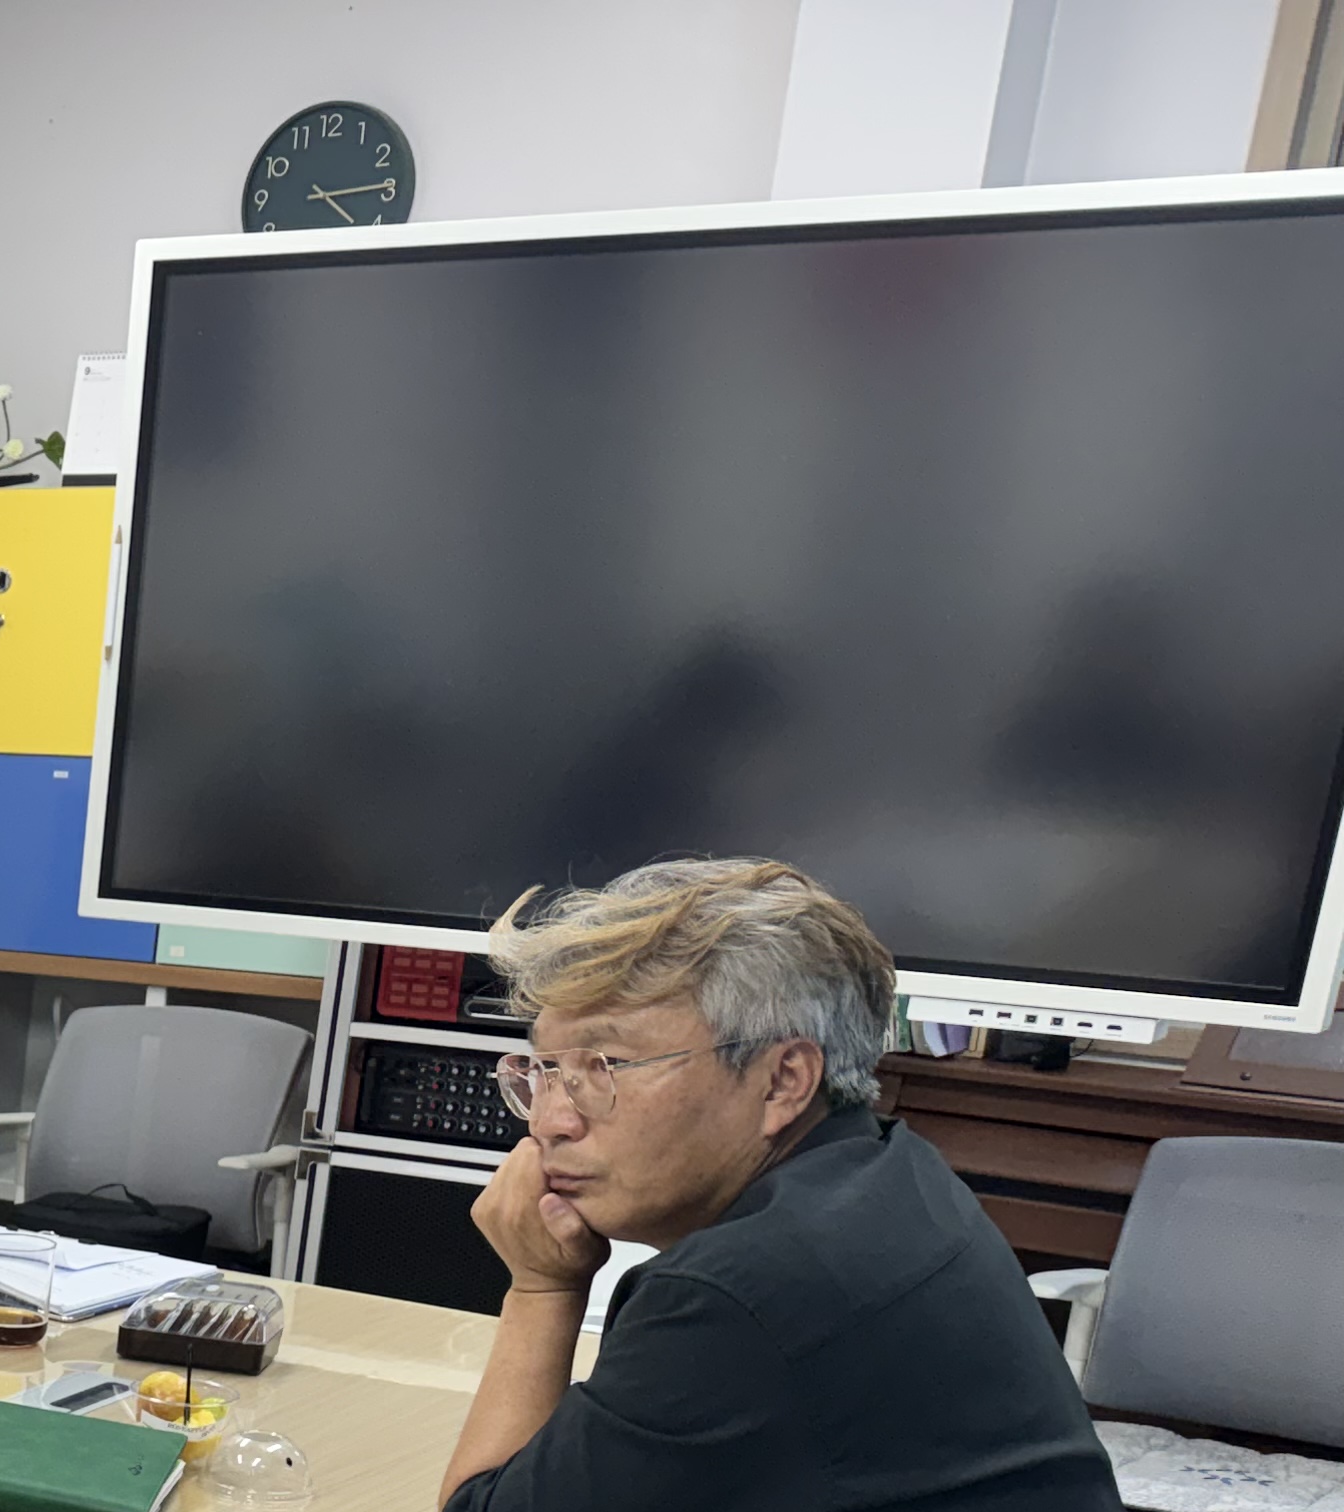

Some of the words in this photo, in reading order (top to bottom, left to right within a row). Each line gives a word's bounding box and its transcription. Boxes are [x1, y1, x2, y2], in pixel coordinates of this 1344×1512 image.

[320, 113, 343, 137] 12
[358, 121, 366, 145] 1
[292, 126, 310, 149] 11
[375, 143, 391, 167] 2
[266, 156, 290, 179] 10
[254, 189, 269, 212] 9
[381, 178, 396, 202] 3
